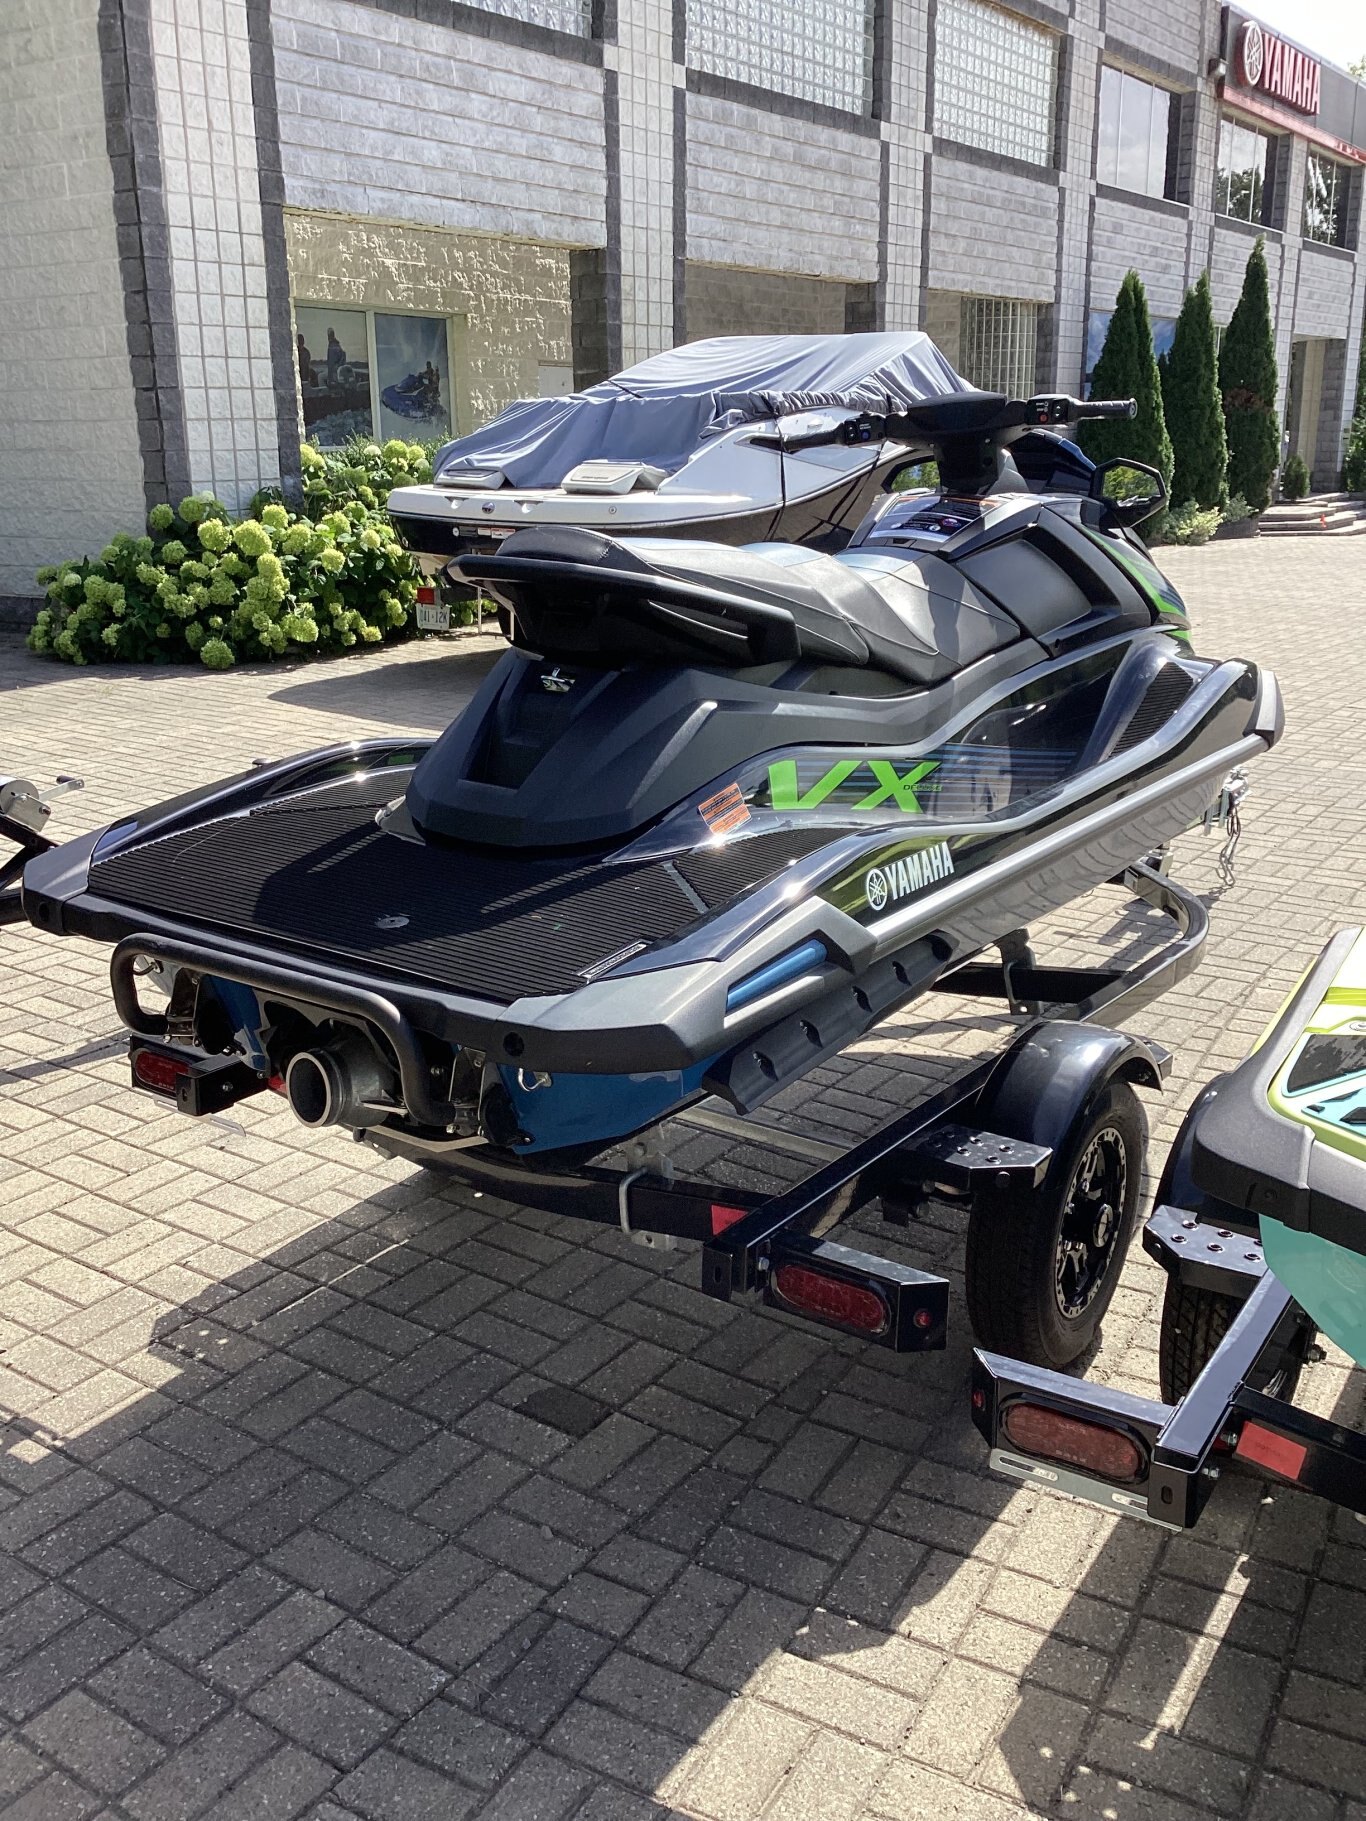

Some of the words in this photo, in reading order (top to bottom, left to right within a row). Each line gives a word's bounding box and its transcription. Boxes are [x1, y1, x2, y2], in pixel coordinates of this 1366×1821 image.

[1264, 33, 1321, 115] YAMAHA
[768, 760, 942, 814] VX
[884, 841, 955, 901] YAMAHA
